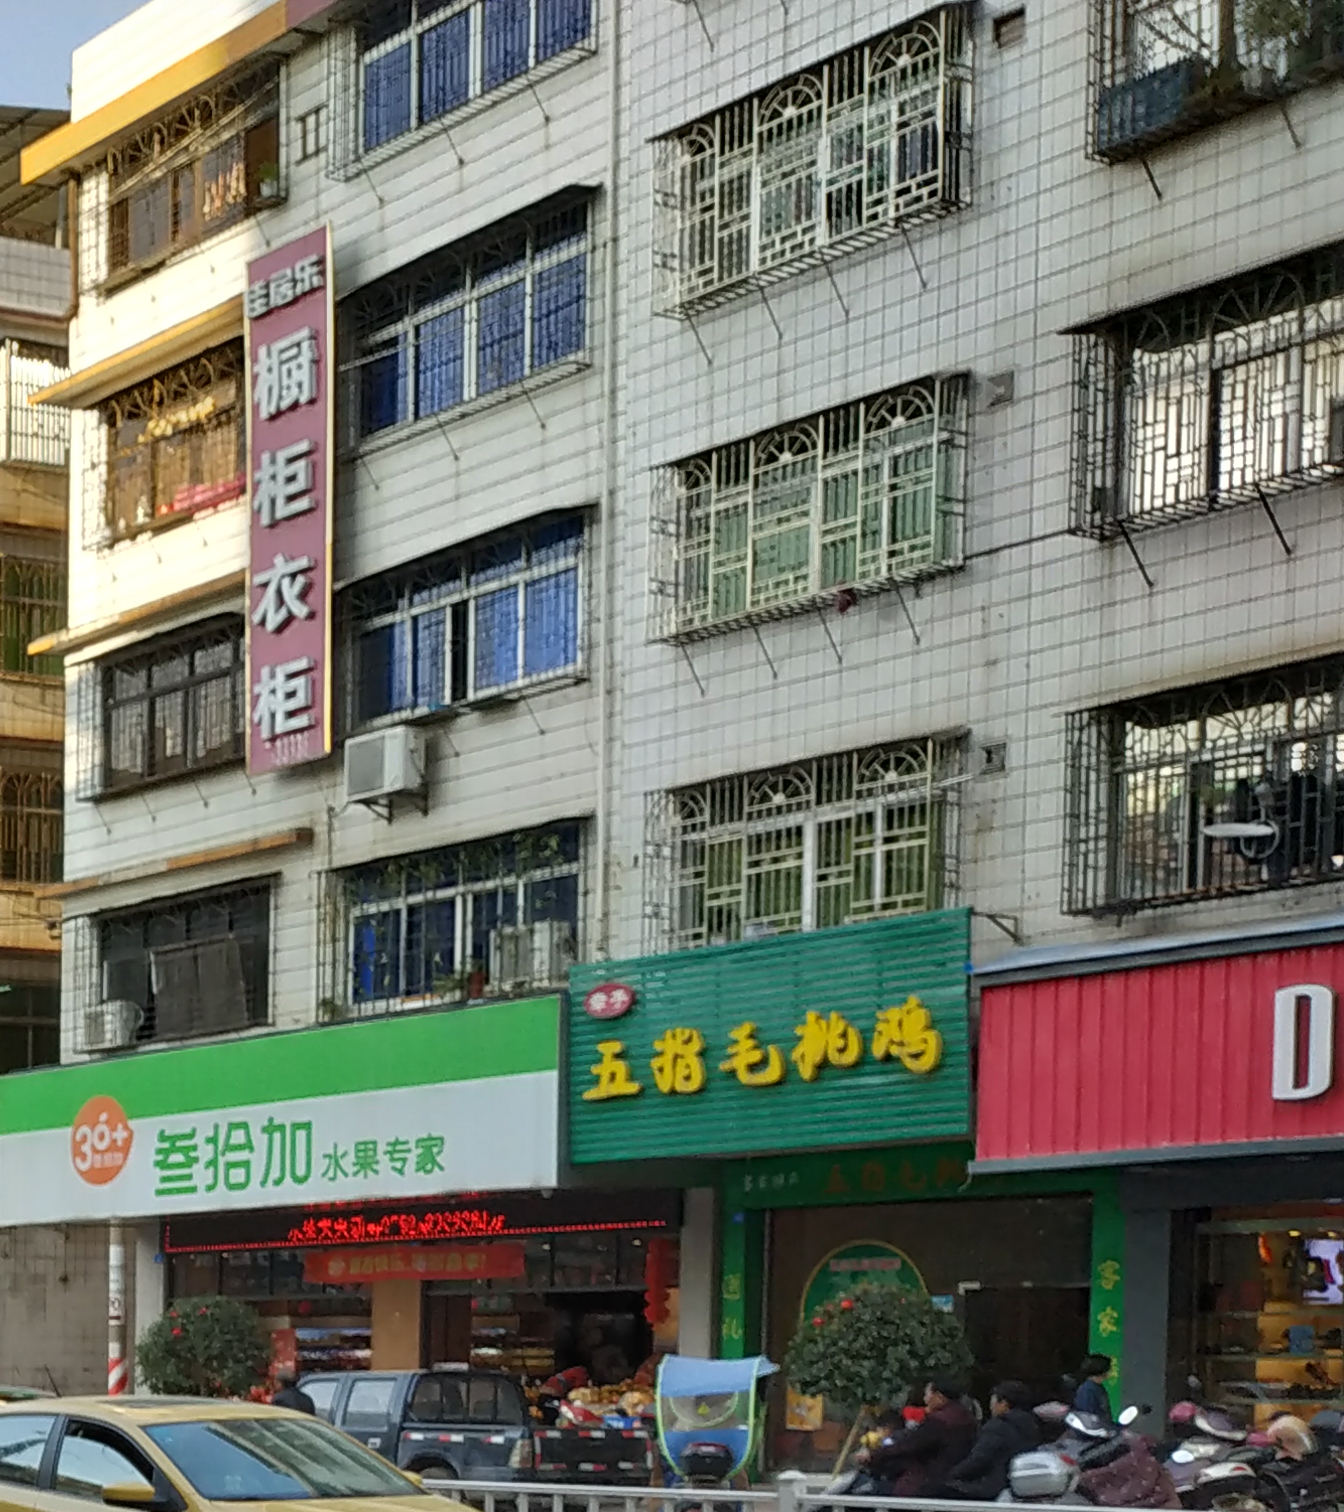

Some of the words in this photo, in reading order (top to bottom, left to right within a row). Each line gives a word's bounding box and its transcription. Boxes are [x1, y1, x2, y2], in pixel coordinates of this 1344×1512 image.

[251, 326, 316, 739] 橱柜衣柜
[582, 994, 943, 1101] 五指毛桃鸡
[321, 1132, 445, 1182] 水果专家
